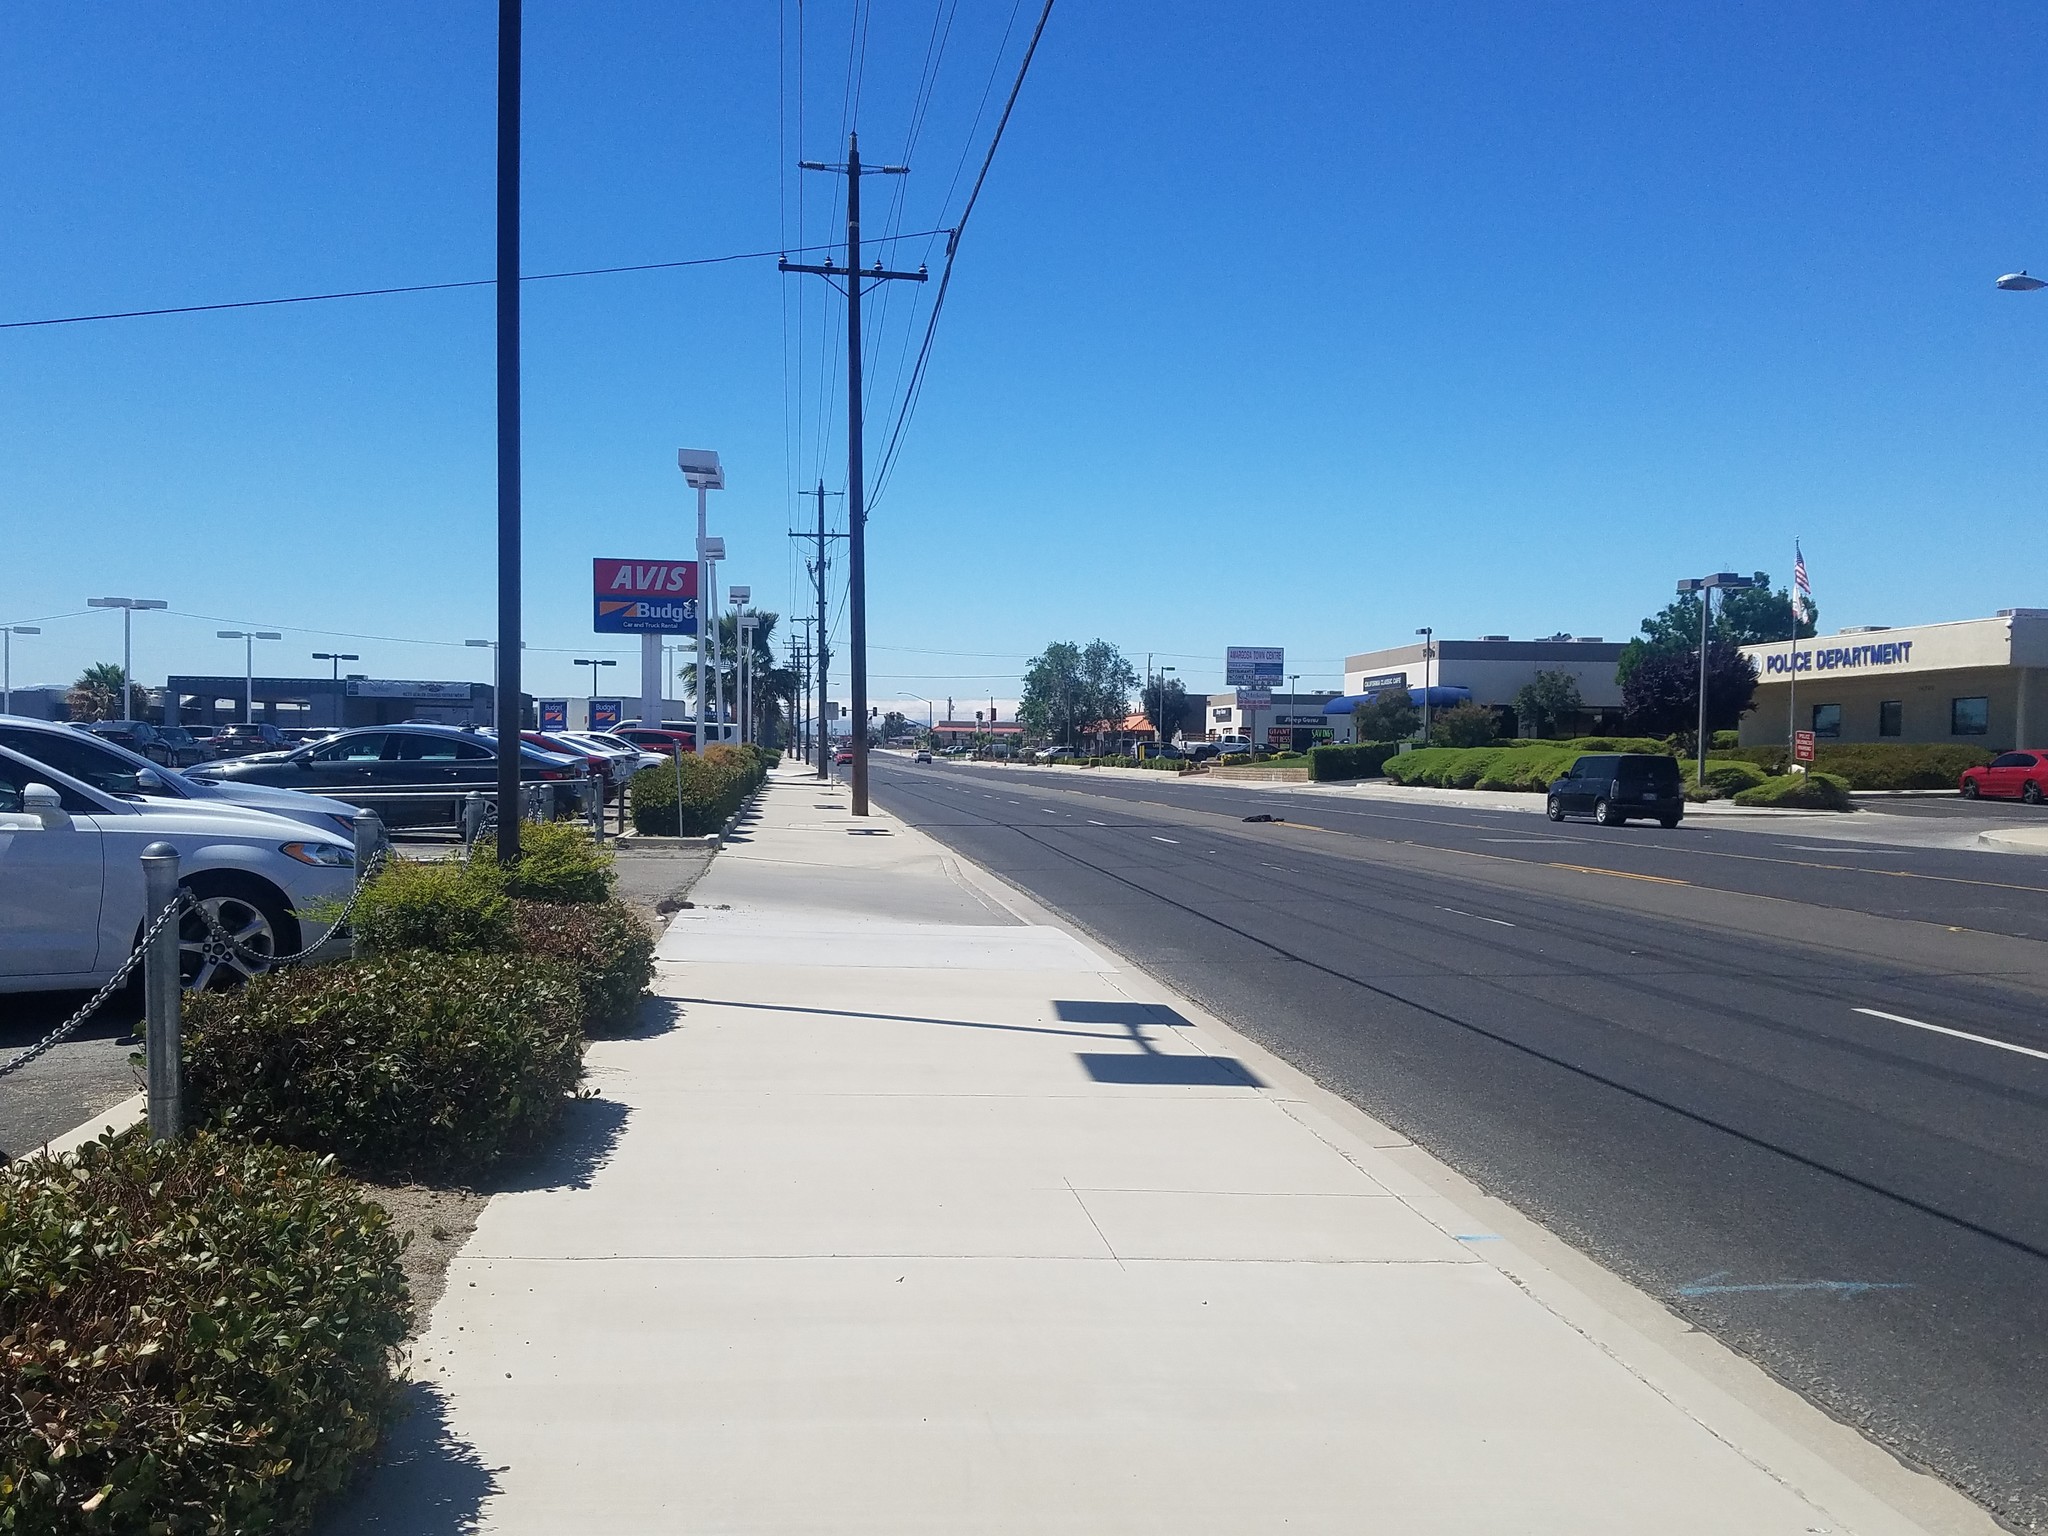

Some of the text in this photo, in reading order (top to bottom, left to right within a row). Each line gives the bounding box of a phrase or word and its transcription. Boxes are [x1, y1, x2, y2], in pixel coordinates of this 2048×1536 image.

[611, 565, 687, 591] AVIS
[636, 602, 698, 623] Budge
[1253, 650, 1265, 660] TOWN
[1266, 651, 1282, 660] CENTRE
[1816, 641, 1913, 671] DEPARTMENT
[545, 704, 563, 713] Budget
[596, 703, 617, 712] Budget
[1311, 728, 1334, 739] SAVINGS
